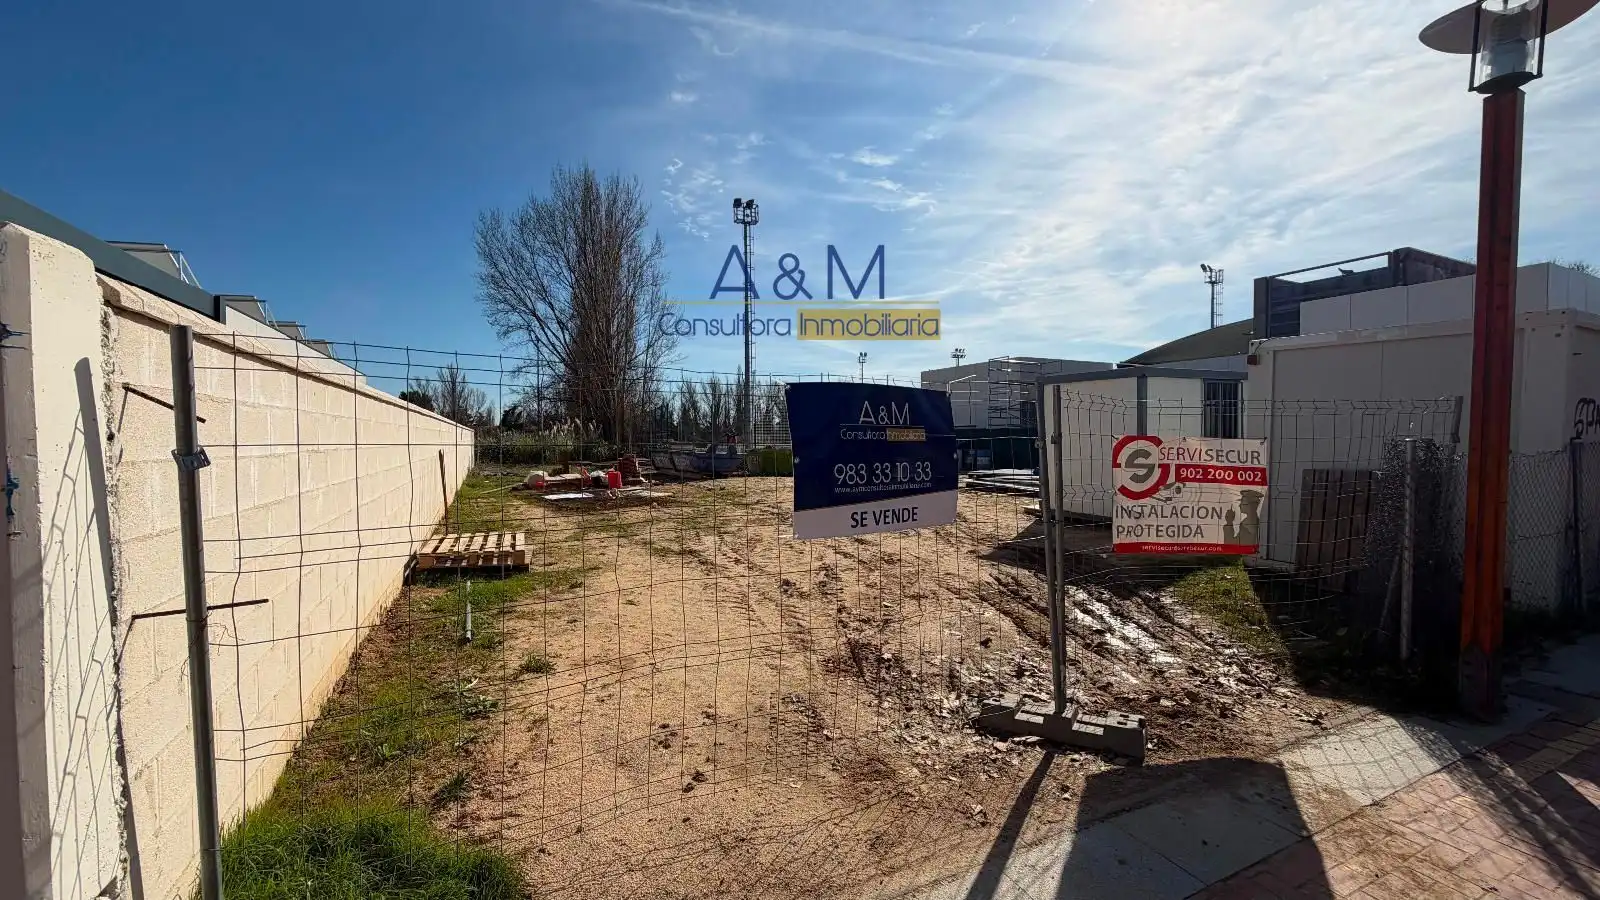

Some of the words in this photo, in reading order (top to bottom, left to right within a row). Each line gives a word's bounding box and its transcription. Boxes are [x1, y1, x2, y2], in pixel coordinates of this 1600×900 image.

[859, 401, 910, 424] A&M
[840, 429, 886, 440] Consultora
[1159, 446, 1261, 465] SERVISECUR
[834, 463, 867, 485] 983
[872, 462, 892, 483] 33
[896, 462, 910, 482] 10
[914, 461, 932, 481] 33
[1180, 467, 1203, 479] 902
[1207, 468, 1234, 480] 200
[1237, 470, 1262, 482] 002
[850, 511, 868, 528] SE
[872, 507, 919, 526] VENDE
[1115, 505, 1223, 520] INSTALACION
[1116, 524, 1205, 539] PROTEGIDA
